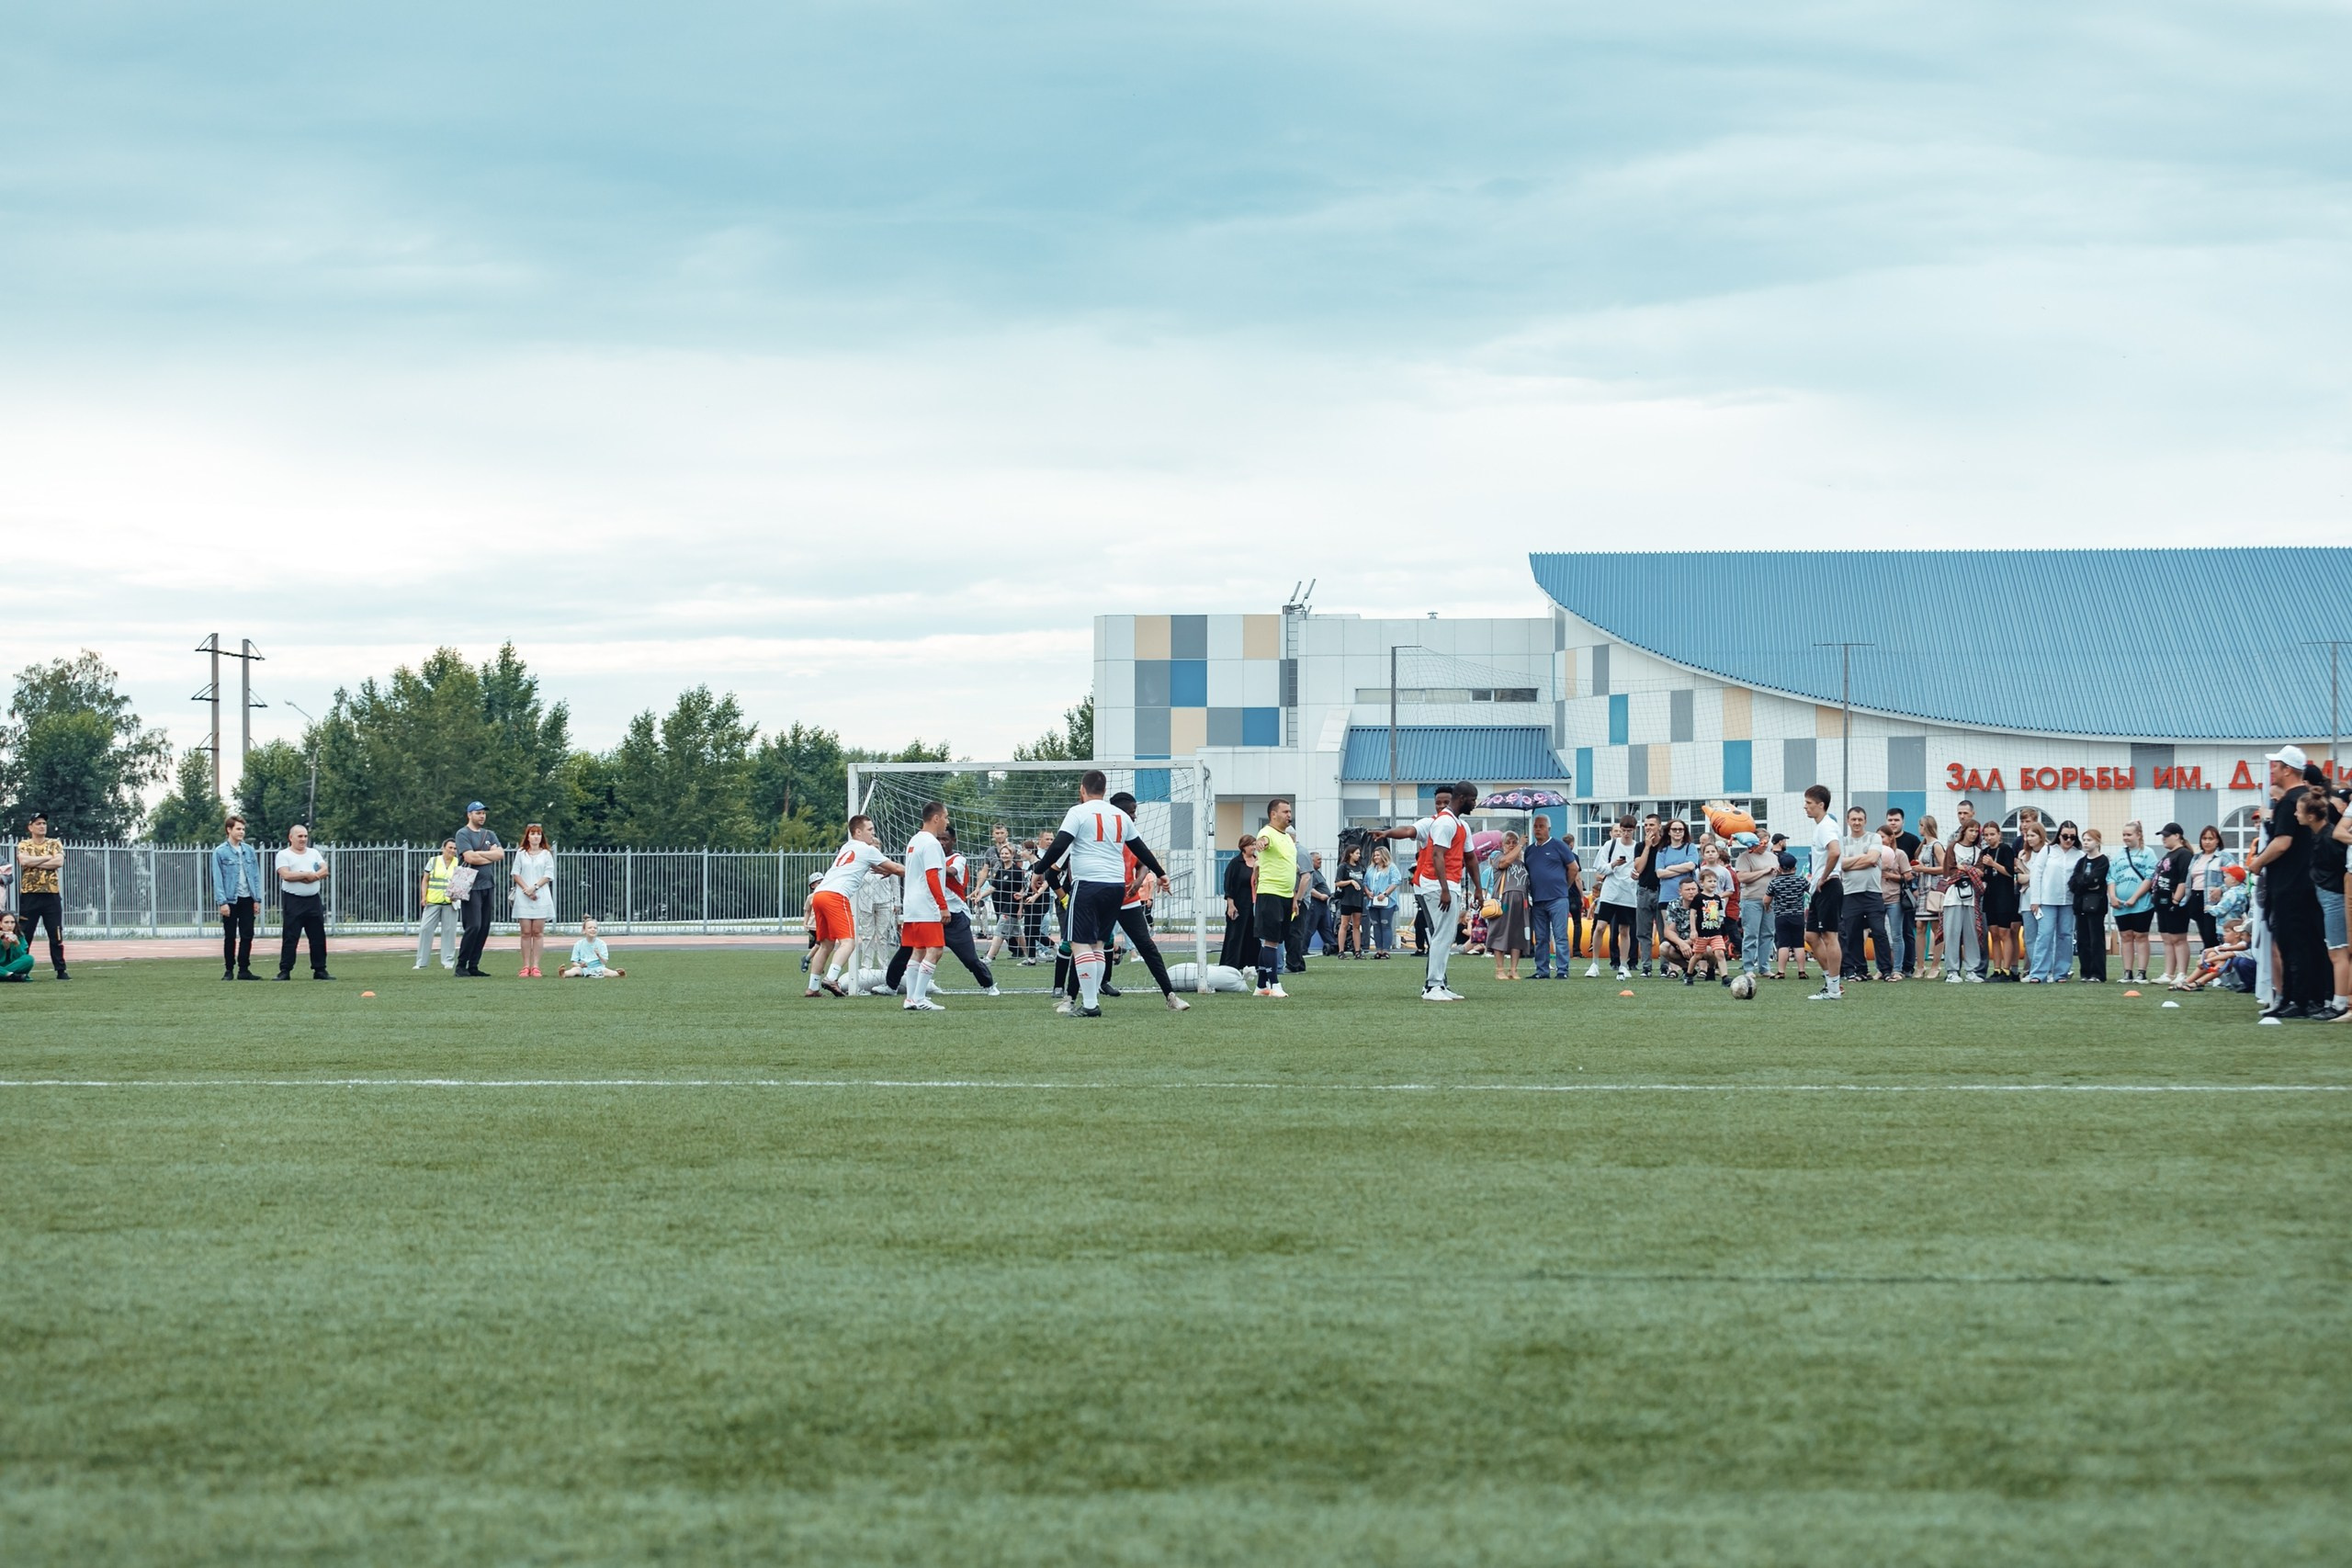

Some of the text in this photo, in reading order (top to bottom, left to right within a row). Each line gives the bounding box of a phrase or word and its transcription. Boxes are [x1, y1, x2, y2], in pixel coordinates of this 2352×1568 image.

[1946, 762, 2006, 791] ЗАЛ
[2020, 766, 2135, 790] БОРЬБЫ
[2154, 766, 2211, 789] ИМ.
[1091, 812, 1123, 843] 11
